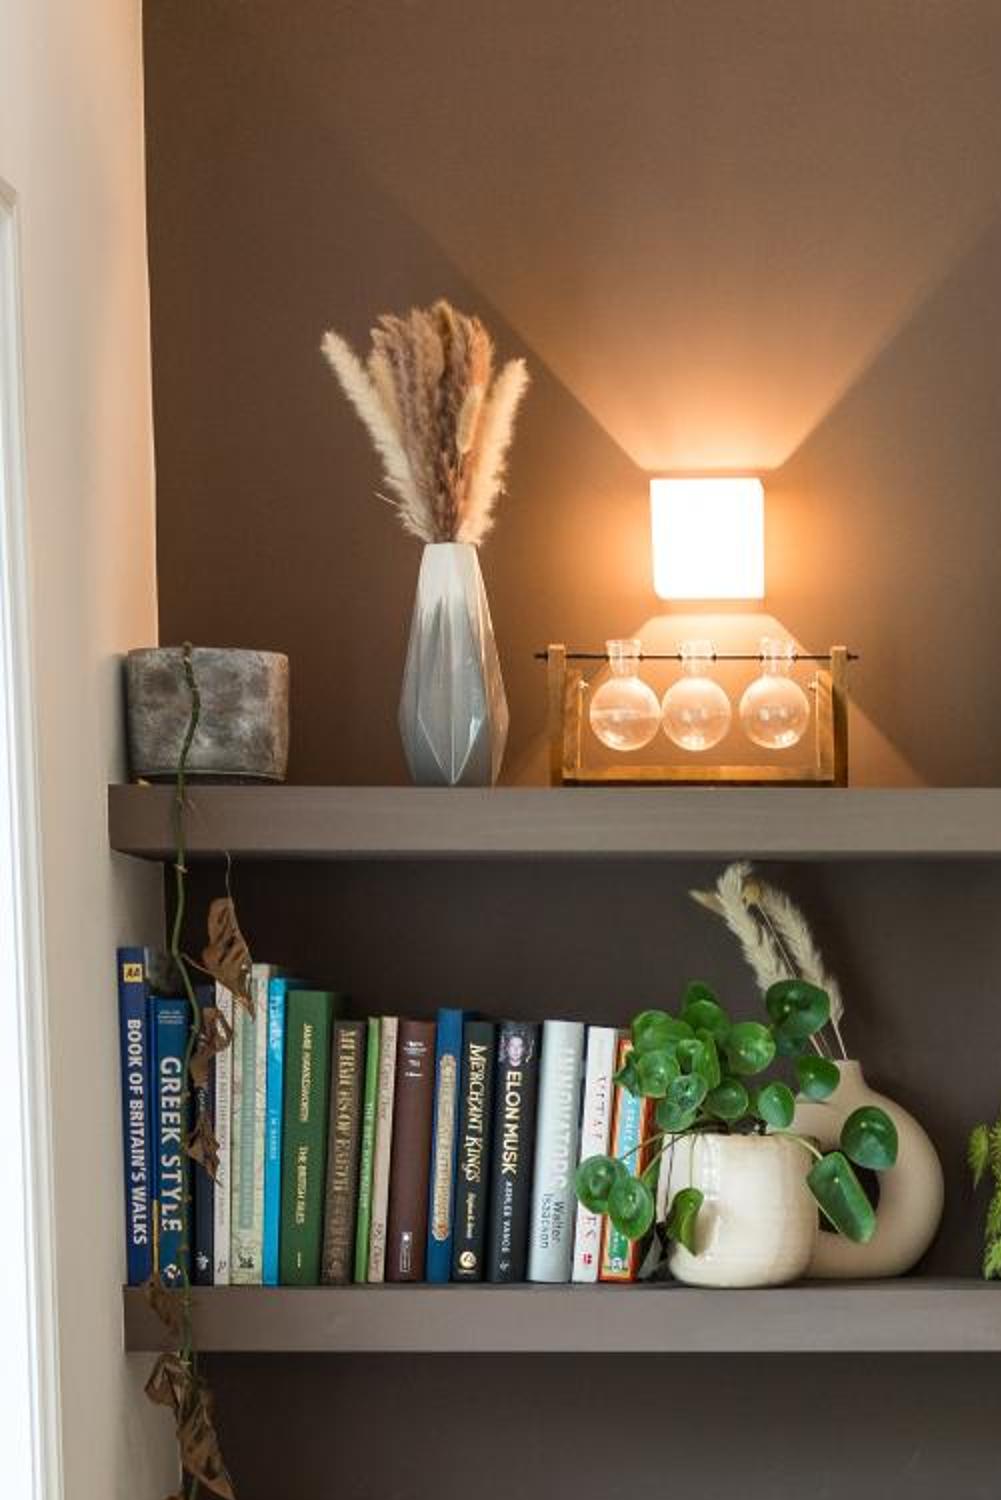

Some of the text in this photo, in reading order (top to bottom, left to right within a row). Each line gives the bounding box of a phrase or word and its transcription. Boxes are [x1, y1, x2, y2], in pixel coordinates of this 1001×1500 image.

[467, 1043, 488, 1134] MERCHANT
[504, 1071, 522, 1120] ELON
[127, 1019, 147, 1245] BOOK OF BRITAIN'S WALKS
[161, 1057, 183, 1232] GREEK STYLE
[463, 1135, 484, 1182] KINGS
[501, 1123, 520, 1175] MUSK
[540, 1193, 553, 1249] Isaacson
[552, 1200, 565, 1244] Walter
